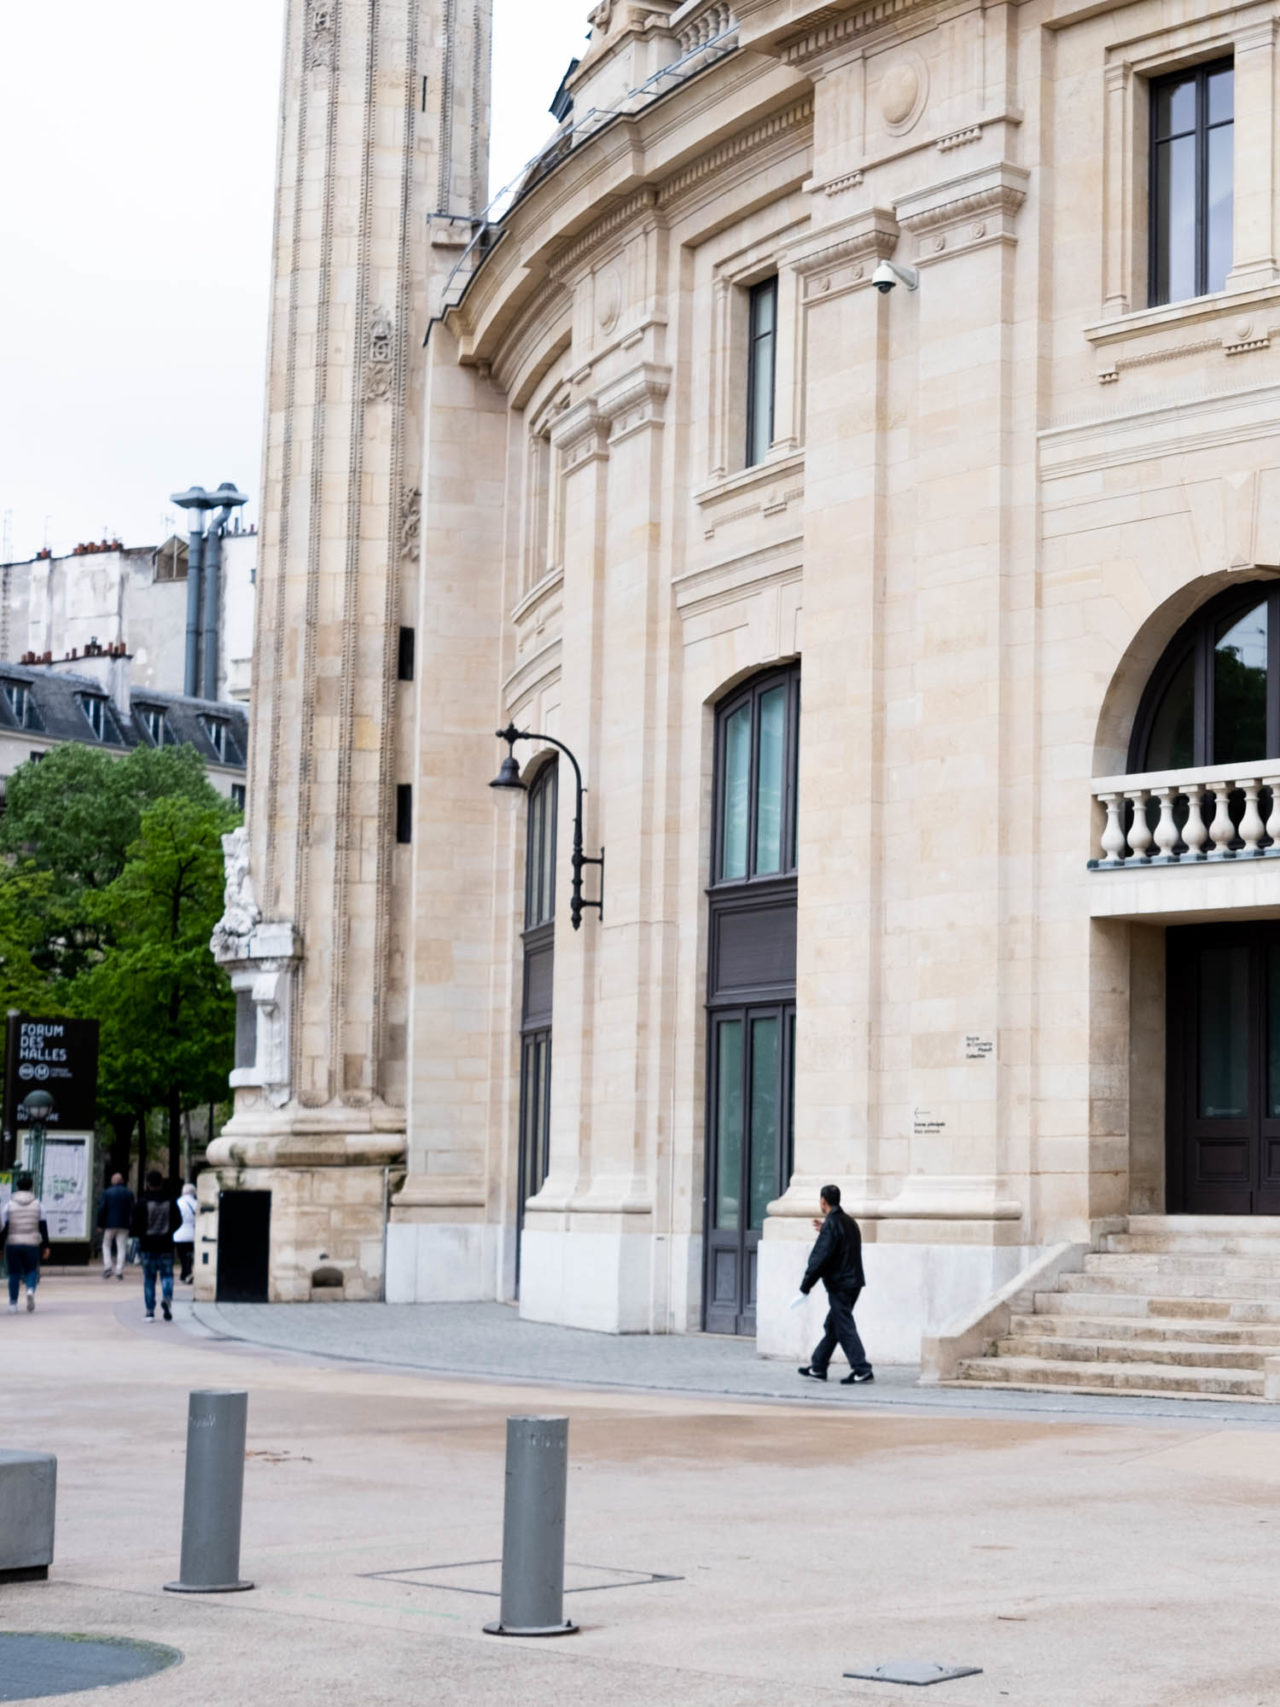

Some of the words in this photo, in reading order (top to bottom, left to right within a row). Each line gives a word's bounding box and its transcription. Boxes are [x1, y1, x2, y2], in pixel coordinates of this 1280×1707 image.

[20, 1023, 65, 1037] FORUM
[20, 1035, 45, 1049] DES
[19, 1047, 68, 1062] HALLES
